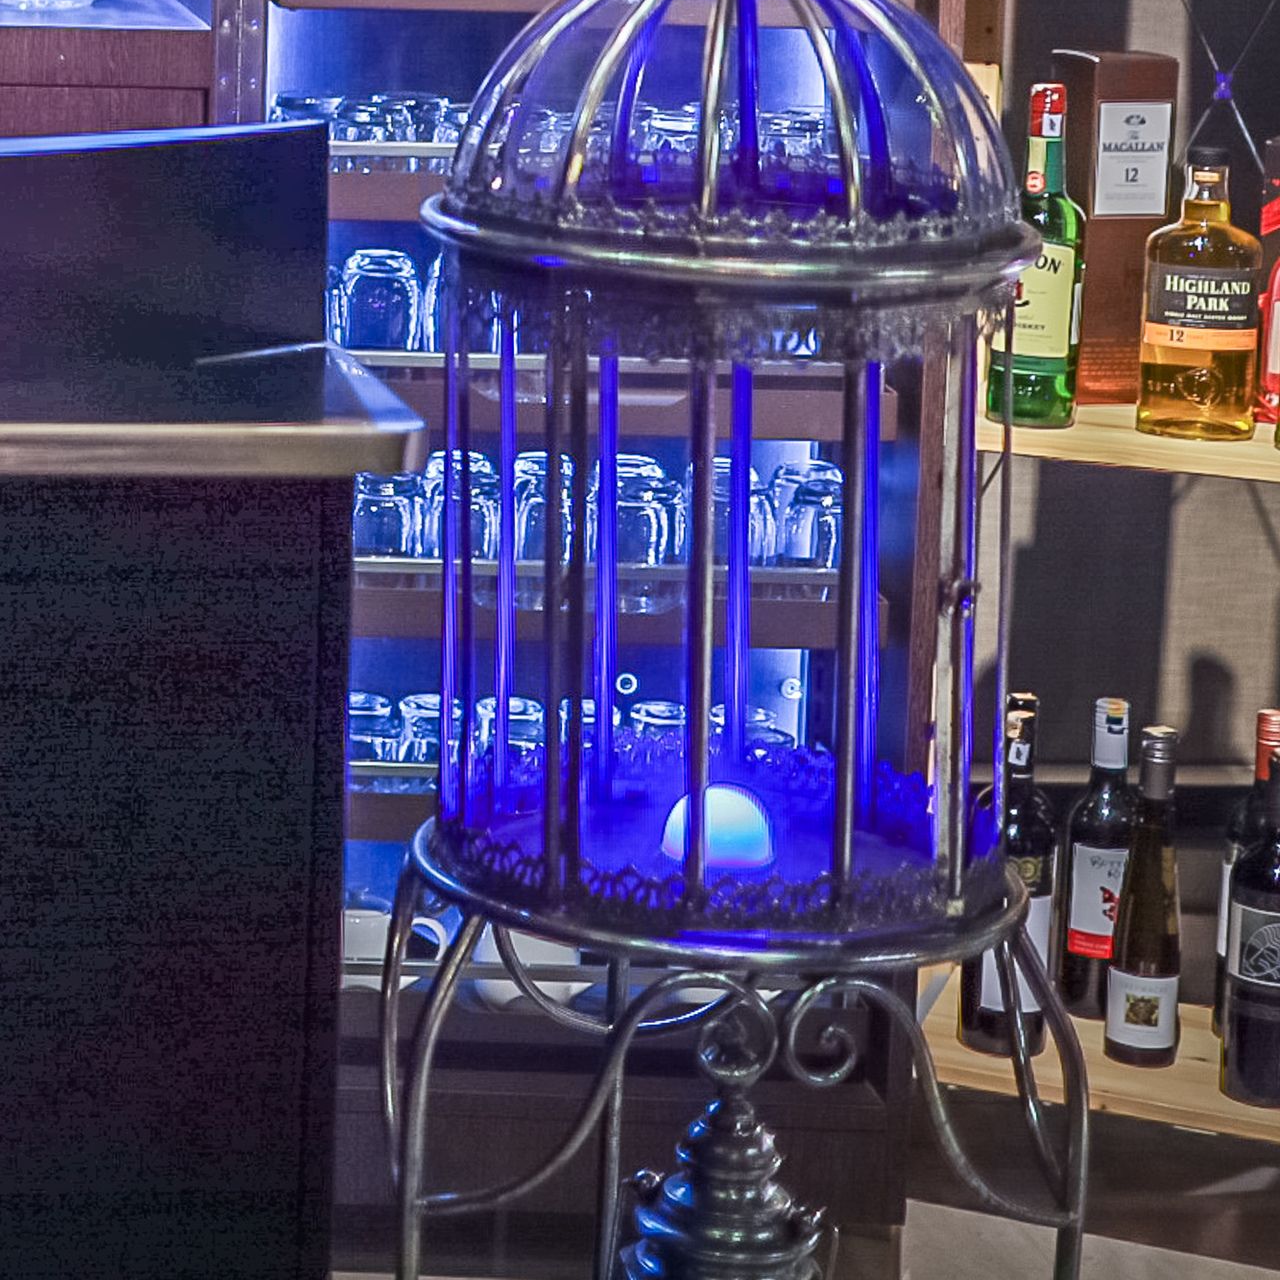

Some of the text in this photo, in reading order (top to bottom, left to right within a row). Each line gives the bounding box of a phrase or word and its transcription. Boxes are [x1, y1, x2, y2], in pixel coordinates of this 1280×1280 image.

[1102, 141, 1166, 153] MACALLAN
[1124, 167, 1139, 183] 12
[1165, 274, 1251, 296] HIGHLAND
[1186, 295, 1230, 312] PARK
[1168, 328, 1185, 342] 12
